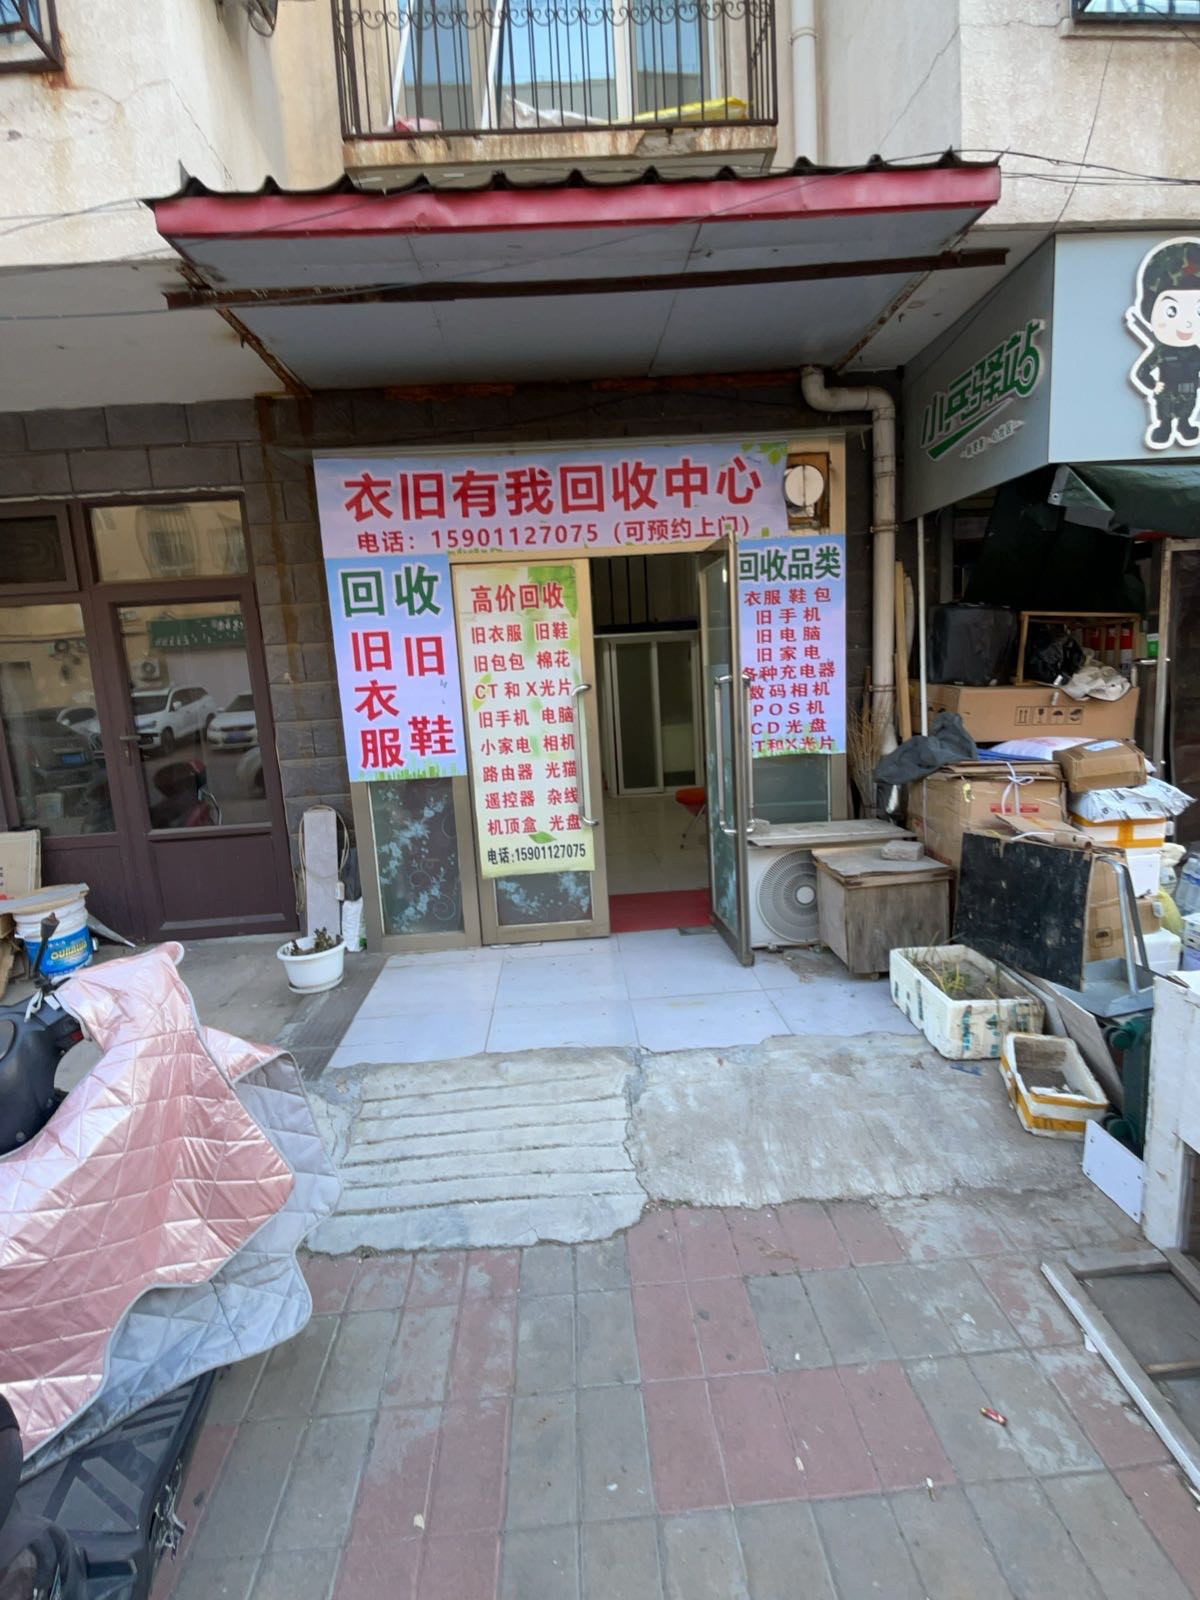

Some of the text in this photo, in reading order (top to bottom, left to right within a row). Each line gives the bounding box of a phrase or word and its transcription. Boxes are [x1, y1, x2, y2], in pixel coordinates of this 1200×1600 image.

[344, 456, 762, 523] 衣旧有我回收中心
[430, 523, 599, 549] 15901127075
[739, 546, 841, 581] 回收品类
[340, 565, 442, 618] 回收
[471, 582, 565, 614] 高价回收
[744, 587, 832, 607] 衣服 鞋 包
[756, 607, 821, 625] 旧手机
[472, 621, 569, 645] 旧衣服 旧鞋
[757, 626, 821, 644] 旧电脑
[473, 650, 571, 673] 旧包包 棉花
[757, 645, 821, 662] 旧家电
[742, 661, 836, 682] 各种充电器
[351, 630, 405, 769] 旧衣服
[750, 682, 830, 701] 数码相机
[479, 705, 575, 729] 旧手机 电脑
[753, 700, 825, 717] POS机
[480, 734, 576, 756] 小家电 相机
[751, 736, 835, 754] T和X光片
[482, 760, 578, 784] 路由器 光猫
[485, 787, 579, 810] 遥控器 杂线
[487, 813, 582, 836] 机顶盒 光盘
